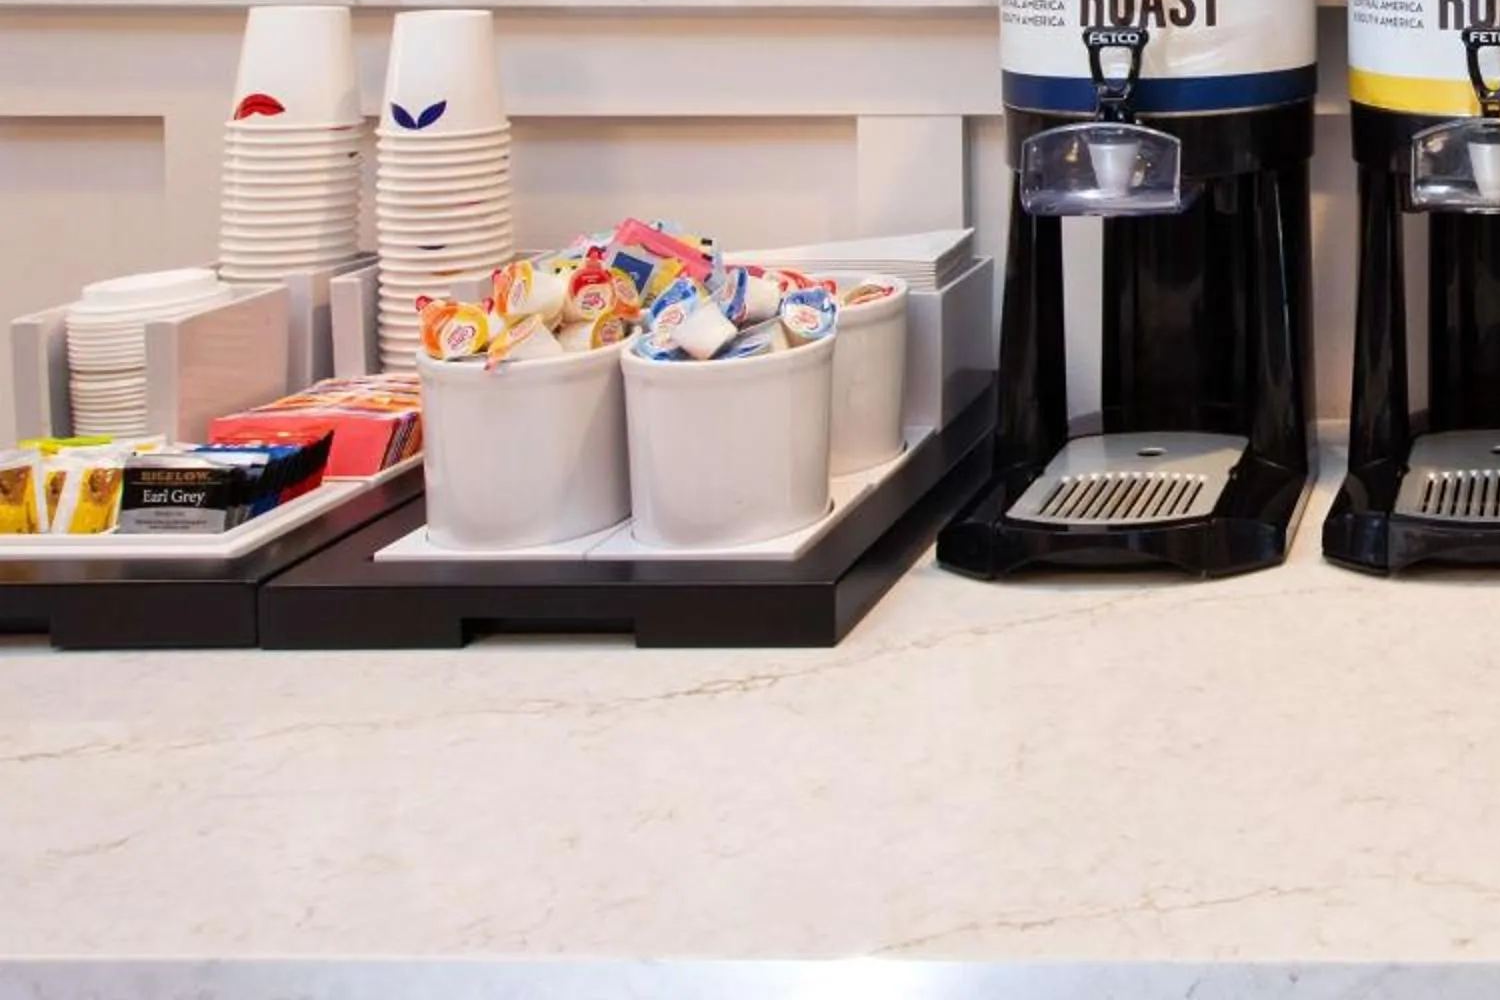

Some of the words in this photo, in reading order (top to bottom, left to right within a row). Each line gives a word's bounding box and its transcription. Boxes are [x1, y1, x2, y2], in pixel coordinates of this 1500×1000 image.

[1089, 30, 1140, 45] FETCO
[143, 488, 168, 503] Earl
[171, 488, 206, 507] Grey
